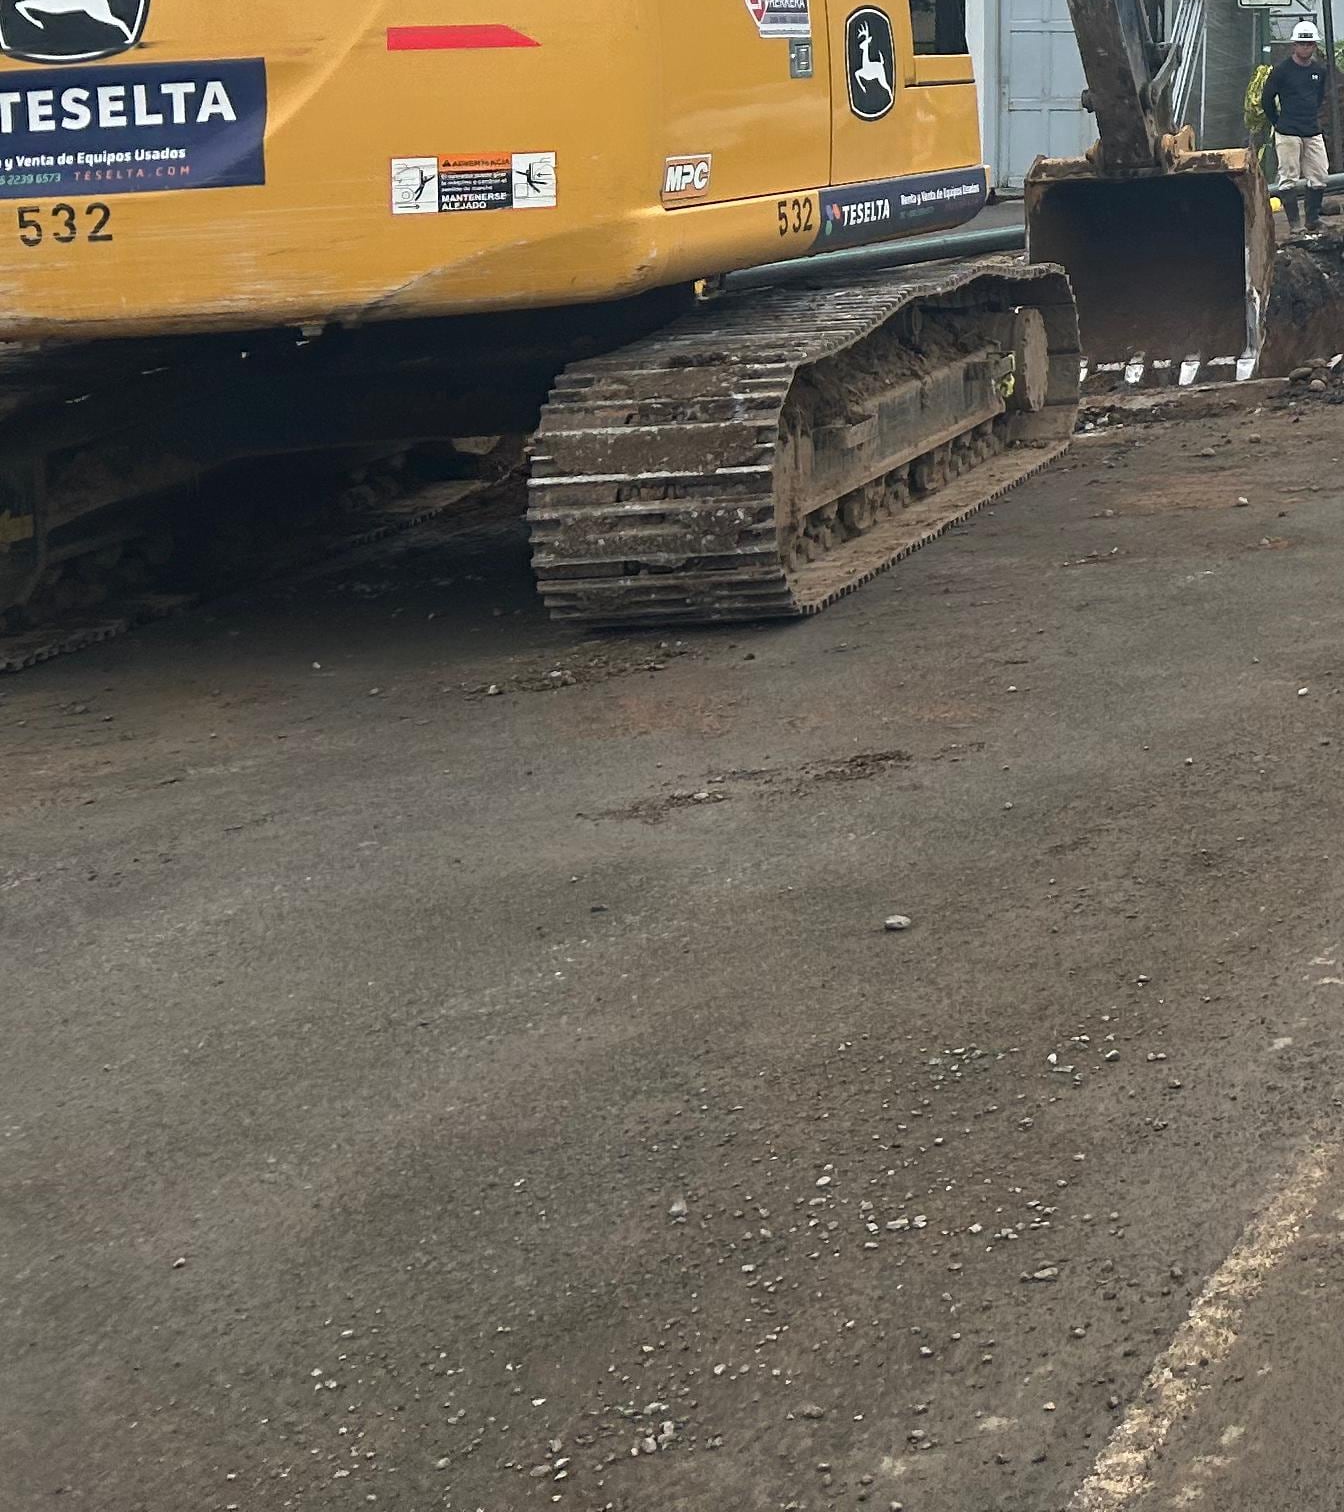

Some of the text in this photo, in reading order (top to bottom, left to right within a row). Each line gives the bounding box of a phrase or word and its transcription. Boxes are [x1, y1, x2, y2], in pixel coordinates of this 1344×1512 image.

[0, 81, 237, 134] TESELTA
[4, 148, 186, 171] y Venta de Equipos Usados
[7, 174, 33, 185] 2239
[36, 173, 62, 183] 6573
[74, 166, 191, 182] TESELTA.COM
[665, 161, 708, 192] MPC
[441, 192, 507, 202] MANTENERSE
[441, 201, 487, 211] ALEJADO
[17, 202, 113, 247] 532
[778, 197, 813, 236] 532
[842, 198, 890, 226] TESELTA
